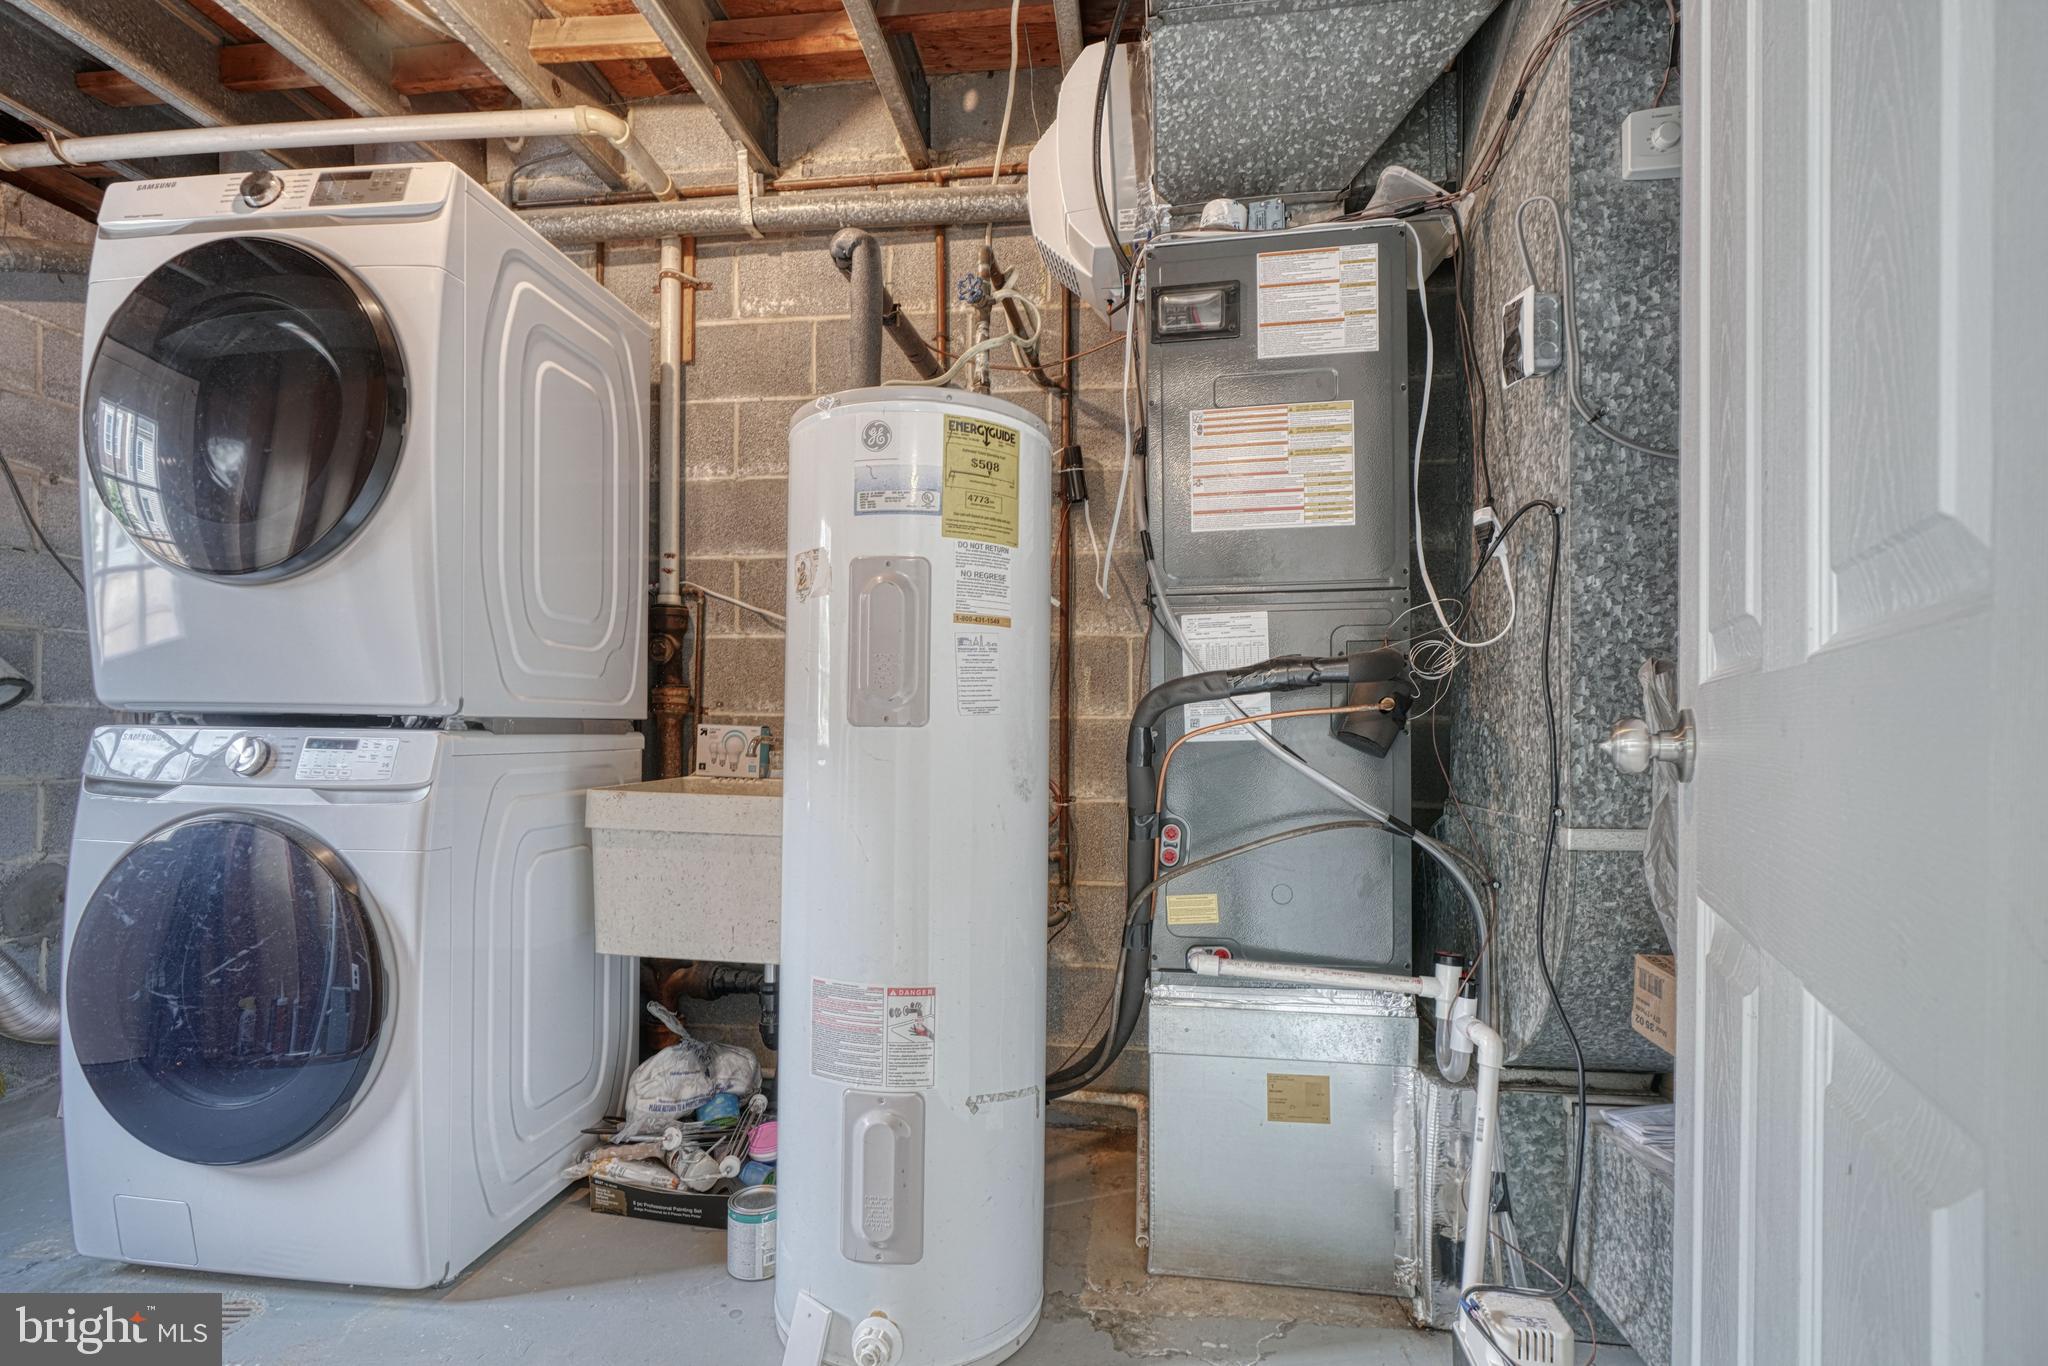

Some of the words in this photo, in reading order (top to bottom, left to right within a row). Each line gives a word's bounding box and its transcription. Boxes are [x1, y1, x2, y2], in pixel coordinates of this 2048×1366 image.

[136, 181, 177, 191] SAMSUNG
[948, 419, 1016, 446] ENERGYGUIDE
[970, 457, 1000, 473] $508
[967, 494, 990, 505] 4773
[957, 541, 968, 549] DO
[969, 542, 984, 551] NOT
[984, 544, 1010, 554] RETURN
[973, 571, 1007, 582] REGRESE
[898, 988, 934, 996] DANGER
[643, 1202, 673, 1211] Professional
[673, 1206, 693, 1214] Painting
